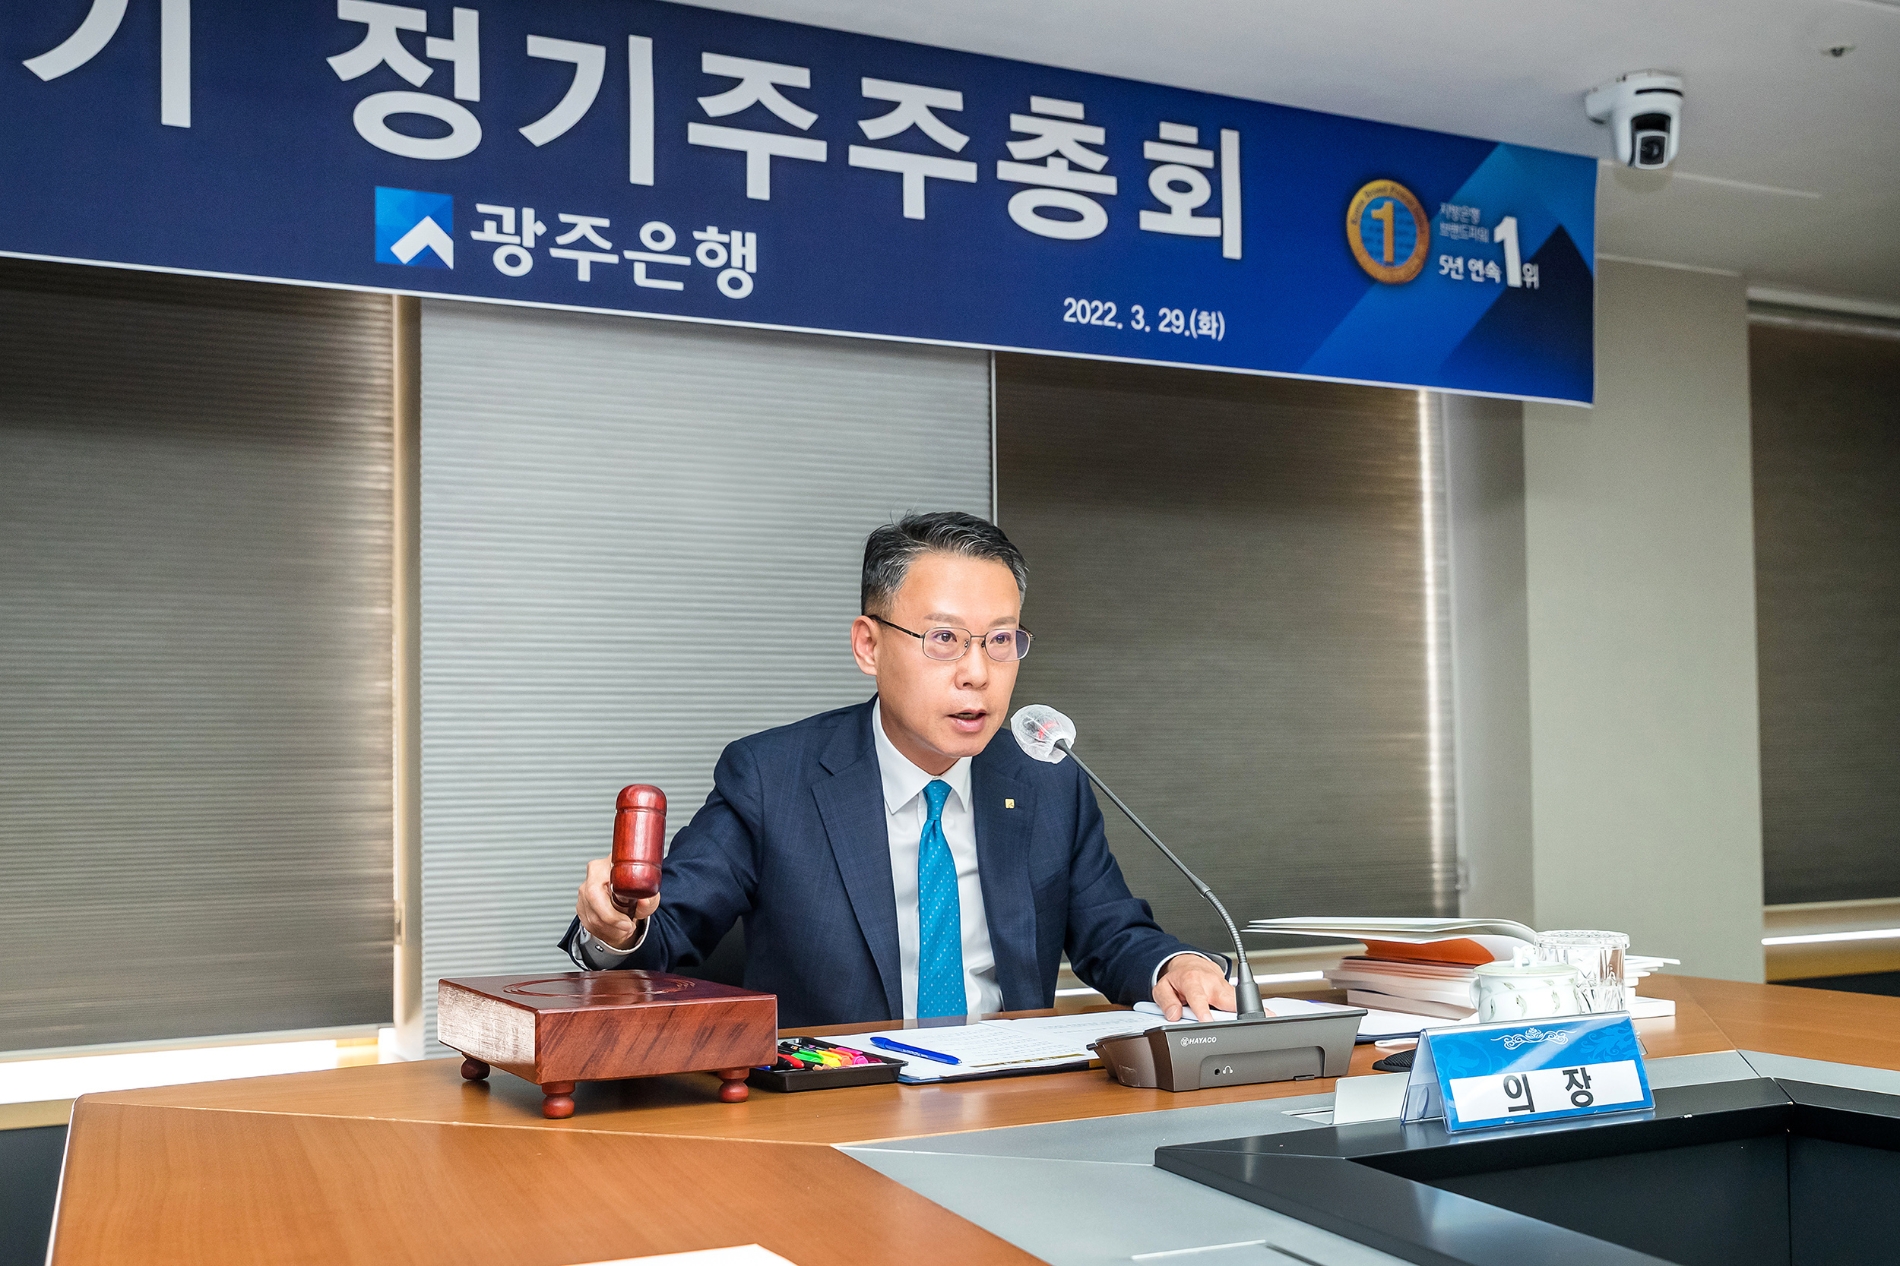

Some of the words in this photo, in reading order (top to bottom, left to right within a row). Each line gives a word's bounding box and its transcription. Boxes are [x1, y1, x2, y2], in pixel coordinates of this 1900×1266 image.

[326, 0, 1242, 260] 정기주주총회
[470, 203, 757, 299] 광주은행
[1439, 254, 1465, 280] 5년
[1467, 258, 1502, 284] 연속
[1063, 297, 1123, 330] 2022.
[1130, 304, 1151, 333] 3.
[1189, 1036, 1217, 1045] HAYACO
